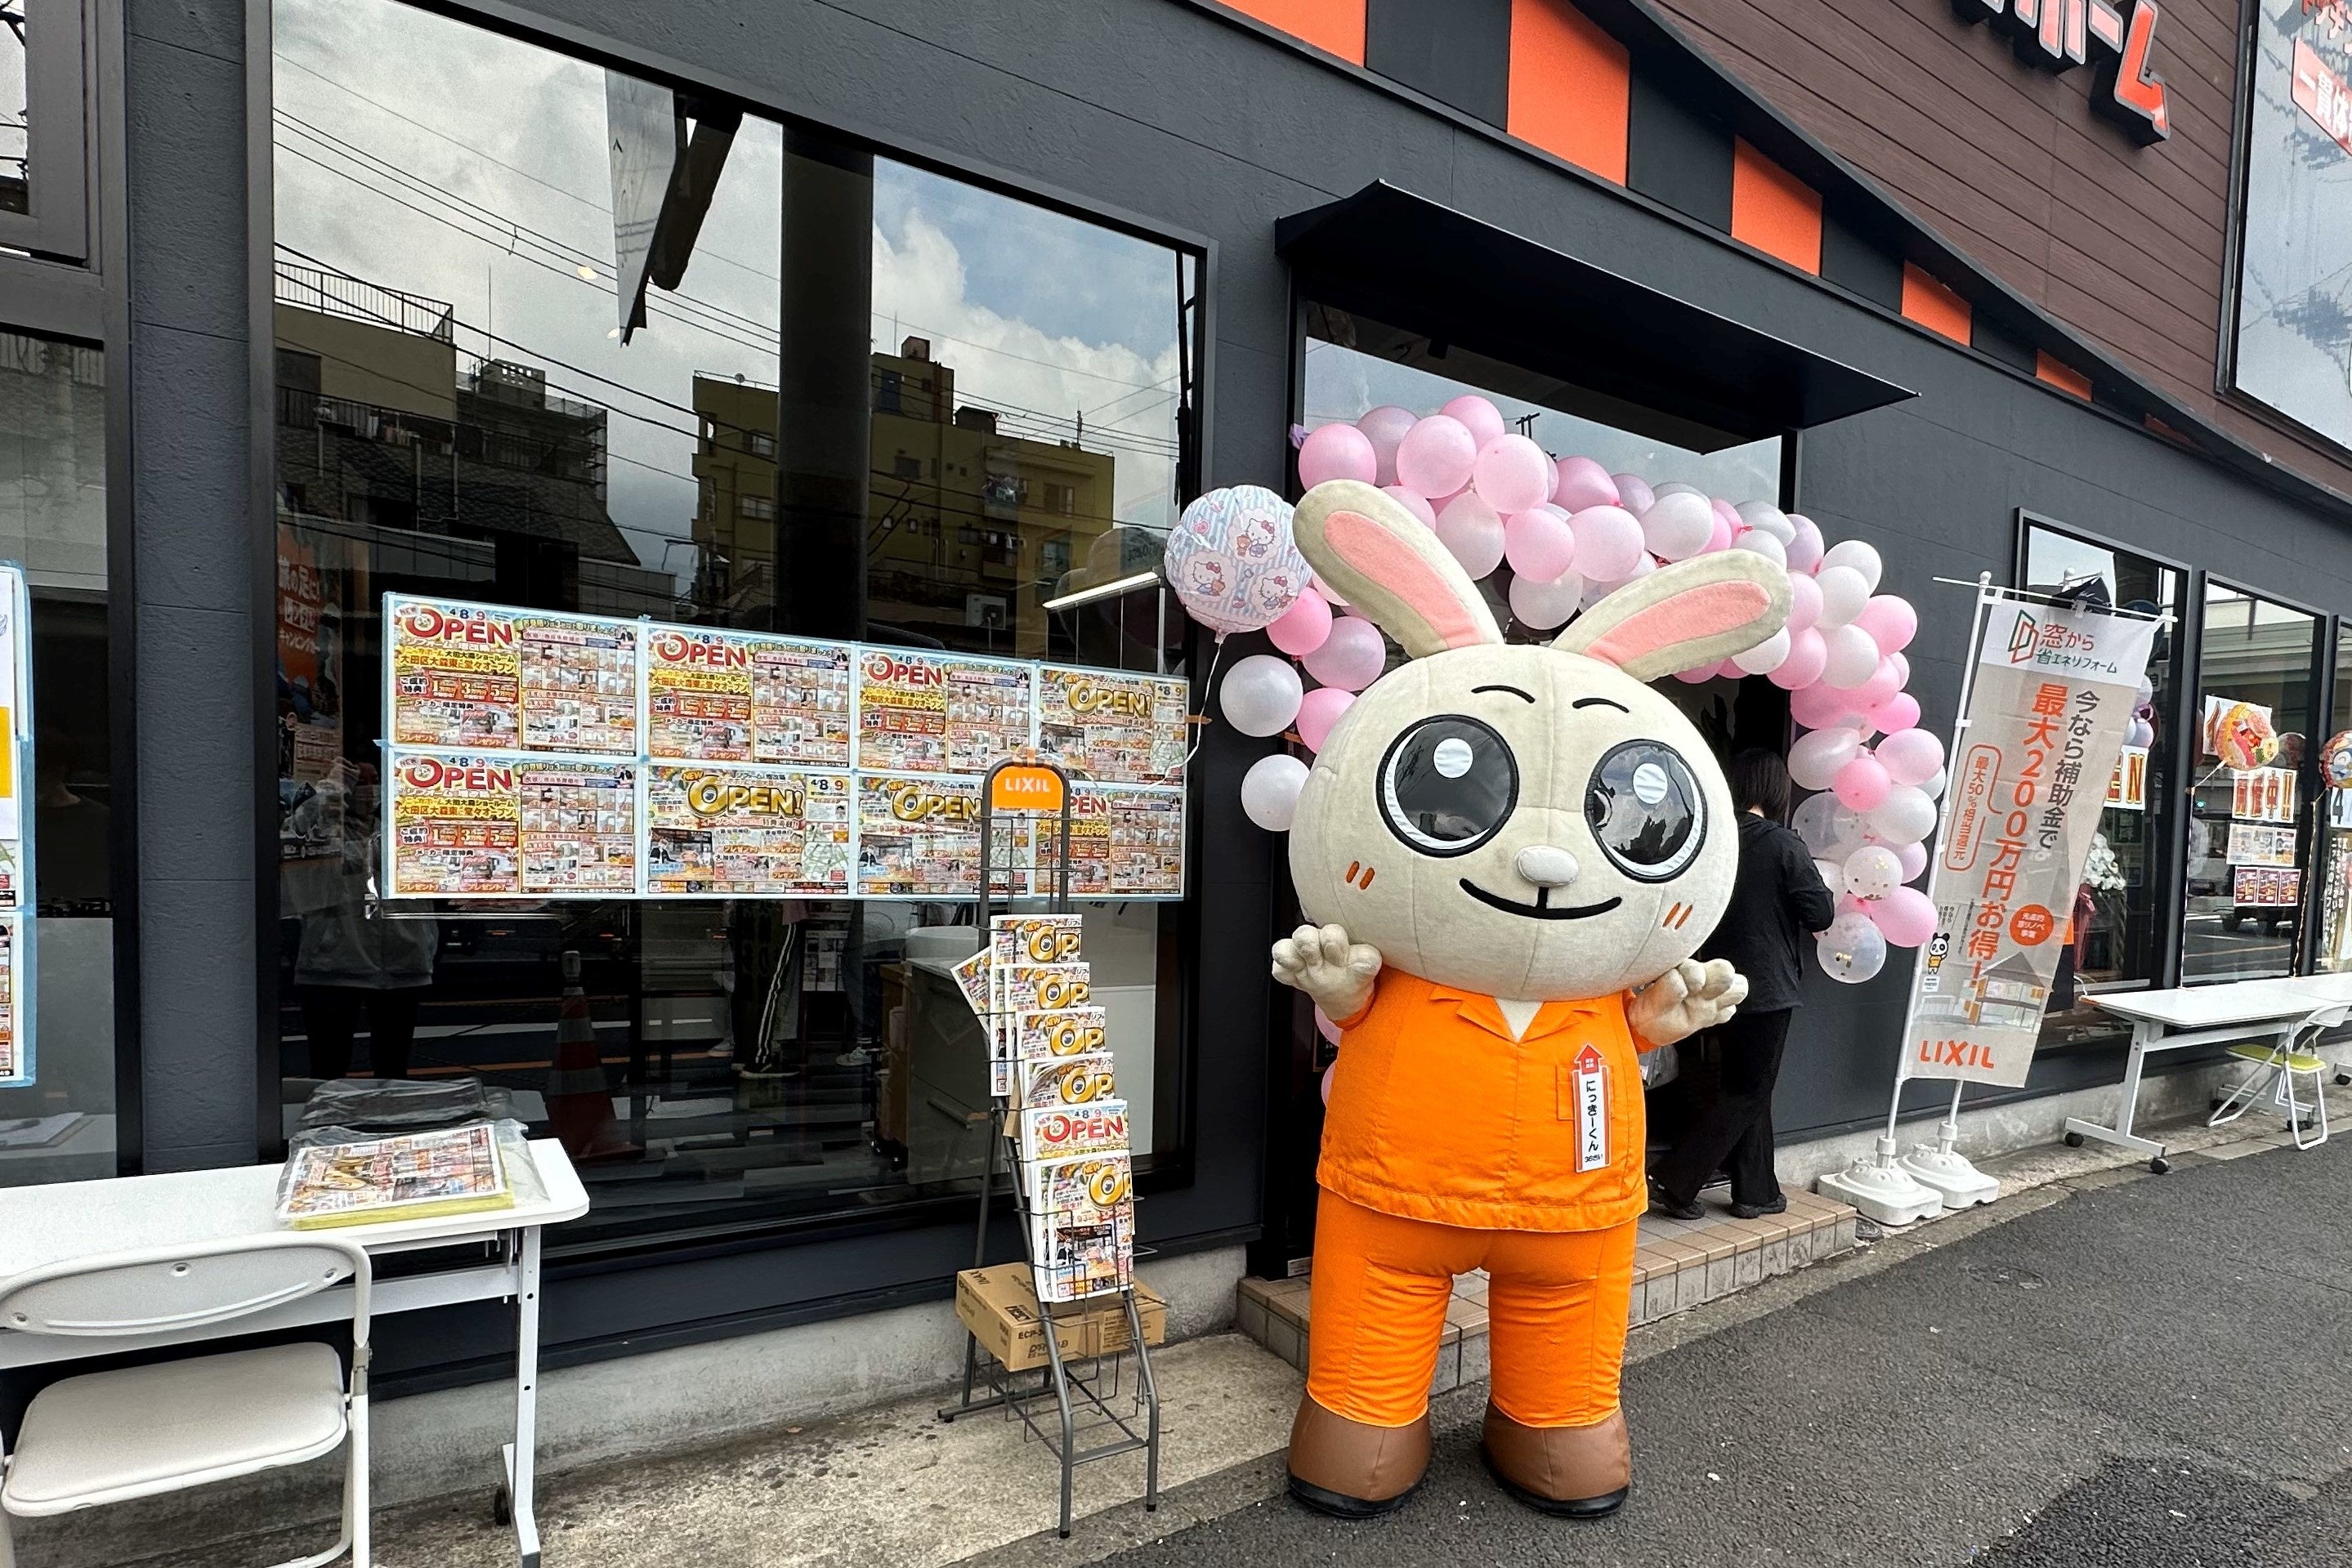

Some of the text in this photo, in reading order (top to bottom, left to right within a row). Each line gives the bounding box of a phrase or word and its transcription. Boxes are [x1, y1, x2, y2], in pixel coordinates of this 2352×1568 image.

[405, 608, 512, 644] OPEN
[2040, 624, 2094, 651] 窓から
[657, 634, 746, 667] OPEN
[2037, 649, 2117, 673] 省エネリフォーム
[868, 655, 942, 685] OPEN
[1069, 679, 1151, 717] OPEN!
[405, 758, 512, 790] OPEN
[683, 771, 703, 780] NEW
[2038, 690, 2100, 849] 今なら補助金で
[688, 775, 803, 815] OPEN!
[1004, 777, 1050, 793] LIXIL
[1070, 797, 1106, 813] PEN
[1921, 1040, 1994, 1069] LIXIL
[1043, 1115, 1123, 1142] OPEN
[1084, 1162, 1101, 1173] NEW
